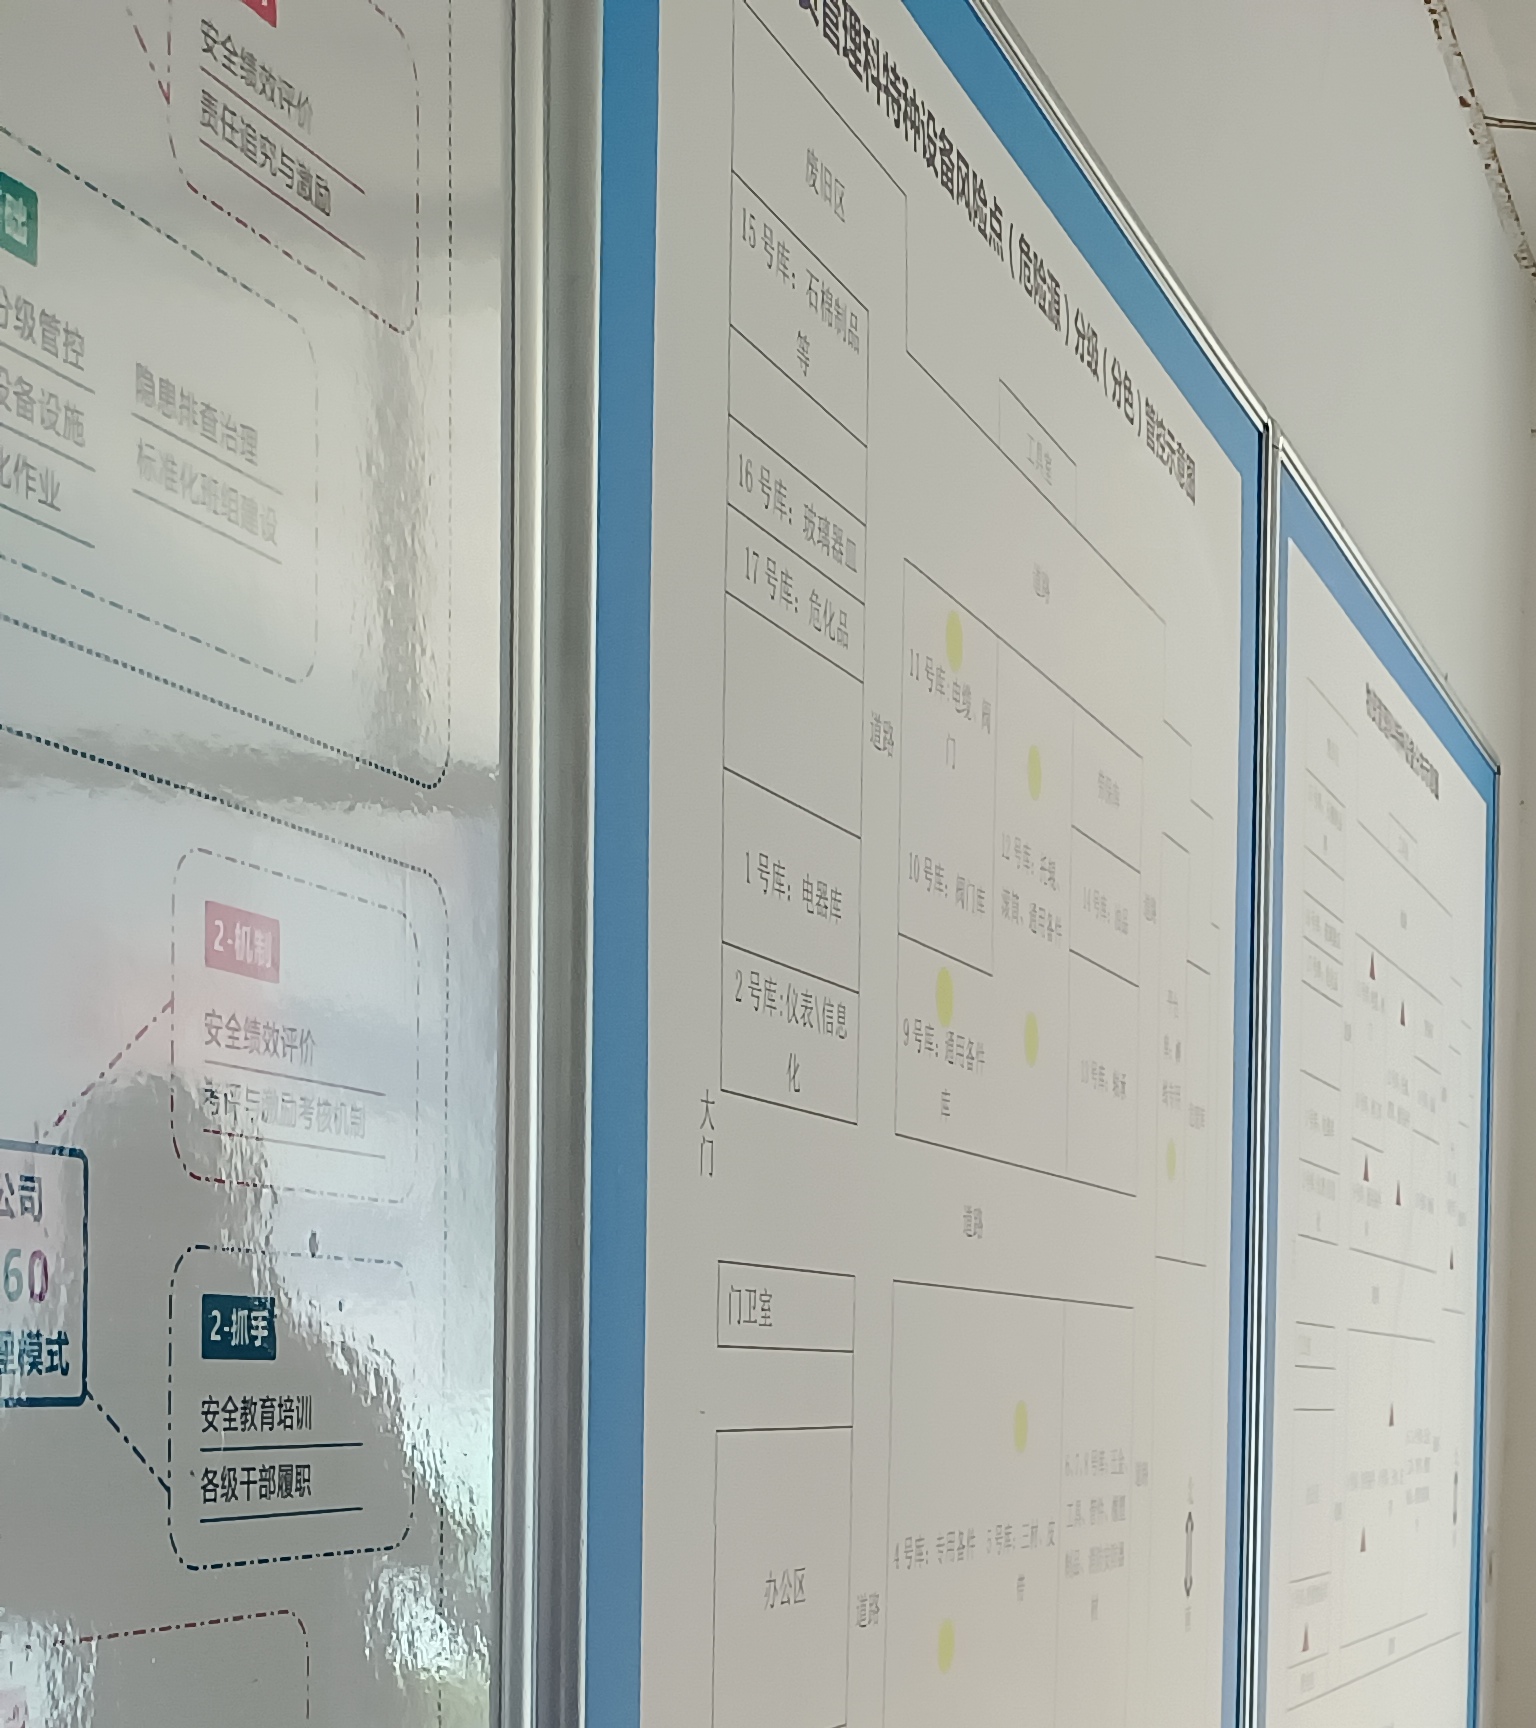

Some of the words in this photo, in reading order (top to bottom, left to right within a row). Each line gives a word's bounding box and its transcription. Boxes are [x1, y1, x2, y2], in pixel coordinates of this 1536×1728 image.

[204, 1007, 317, 1067] 安全绩效评价
[727, 1284, 774, 1329] 门卫室
[200, 1393, 312, 1434] 安全教育培训
[200, 1463, 312, 1504] 各级干部履职
[763, 1566, 807, 1611] 办公区
